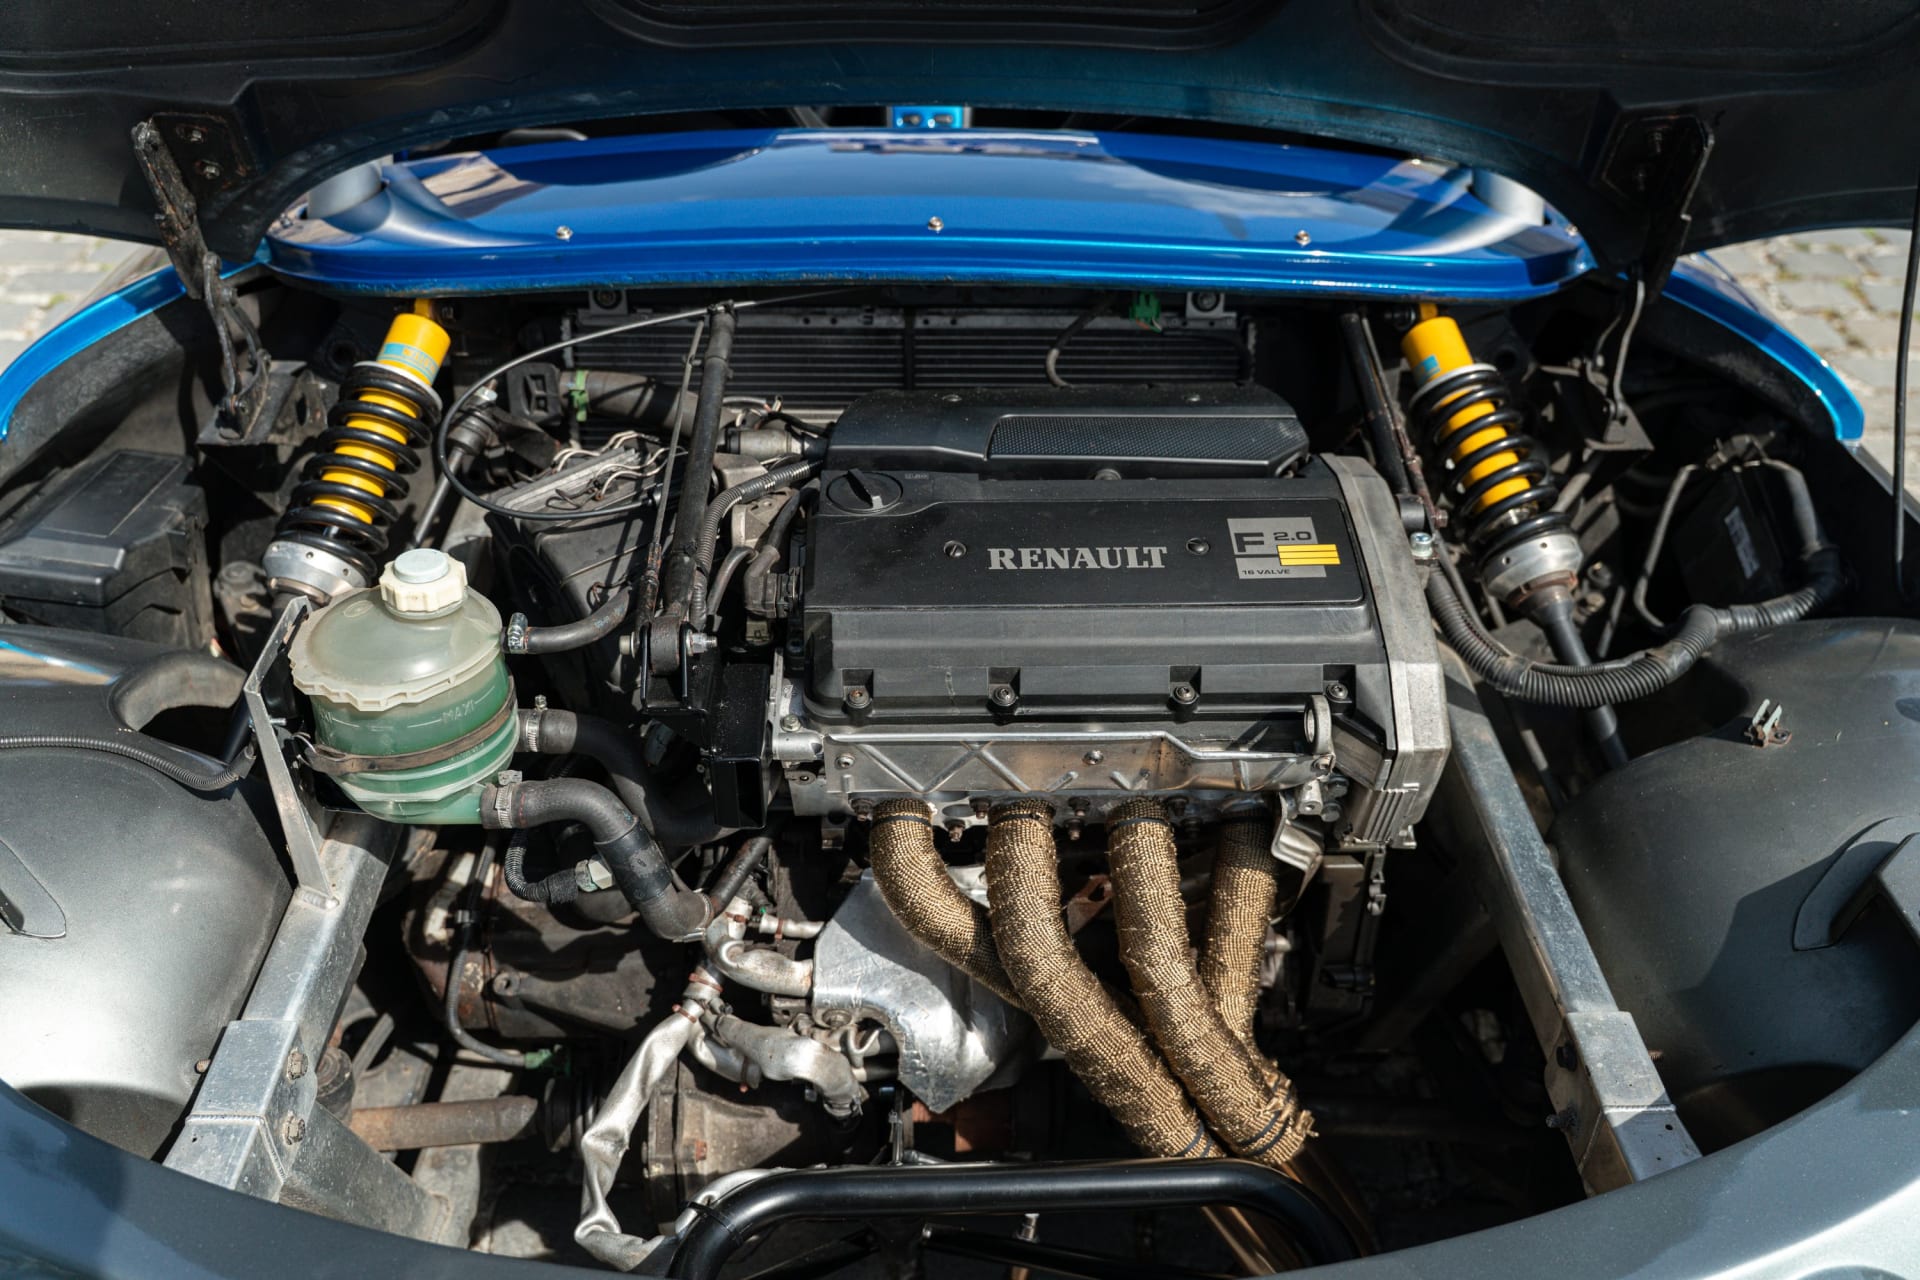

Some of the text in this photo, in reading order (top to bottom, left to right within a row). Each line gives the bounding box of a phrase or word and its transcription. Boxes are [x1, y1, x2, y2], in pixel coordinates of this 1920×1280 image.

[1234, 531, 1312, 553] F 2.0
[987, 546, 1168, 570] RENAULT
